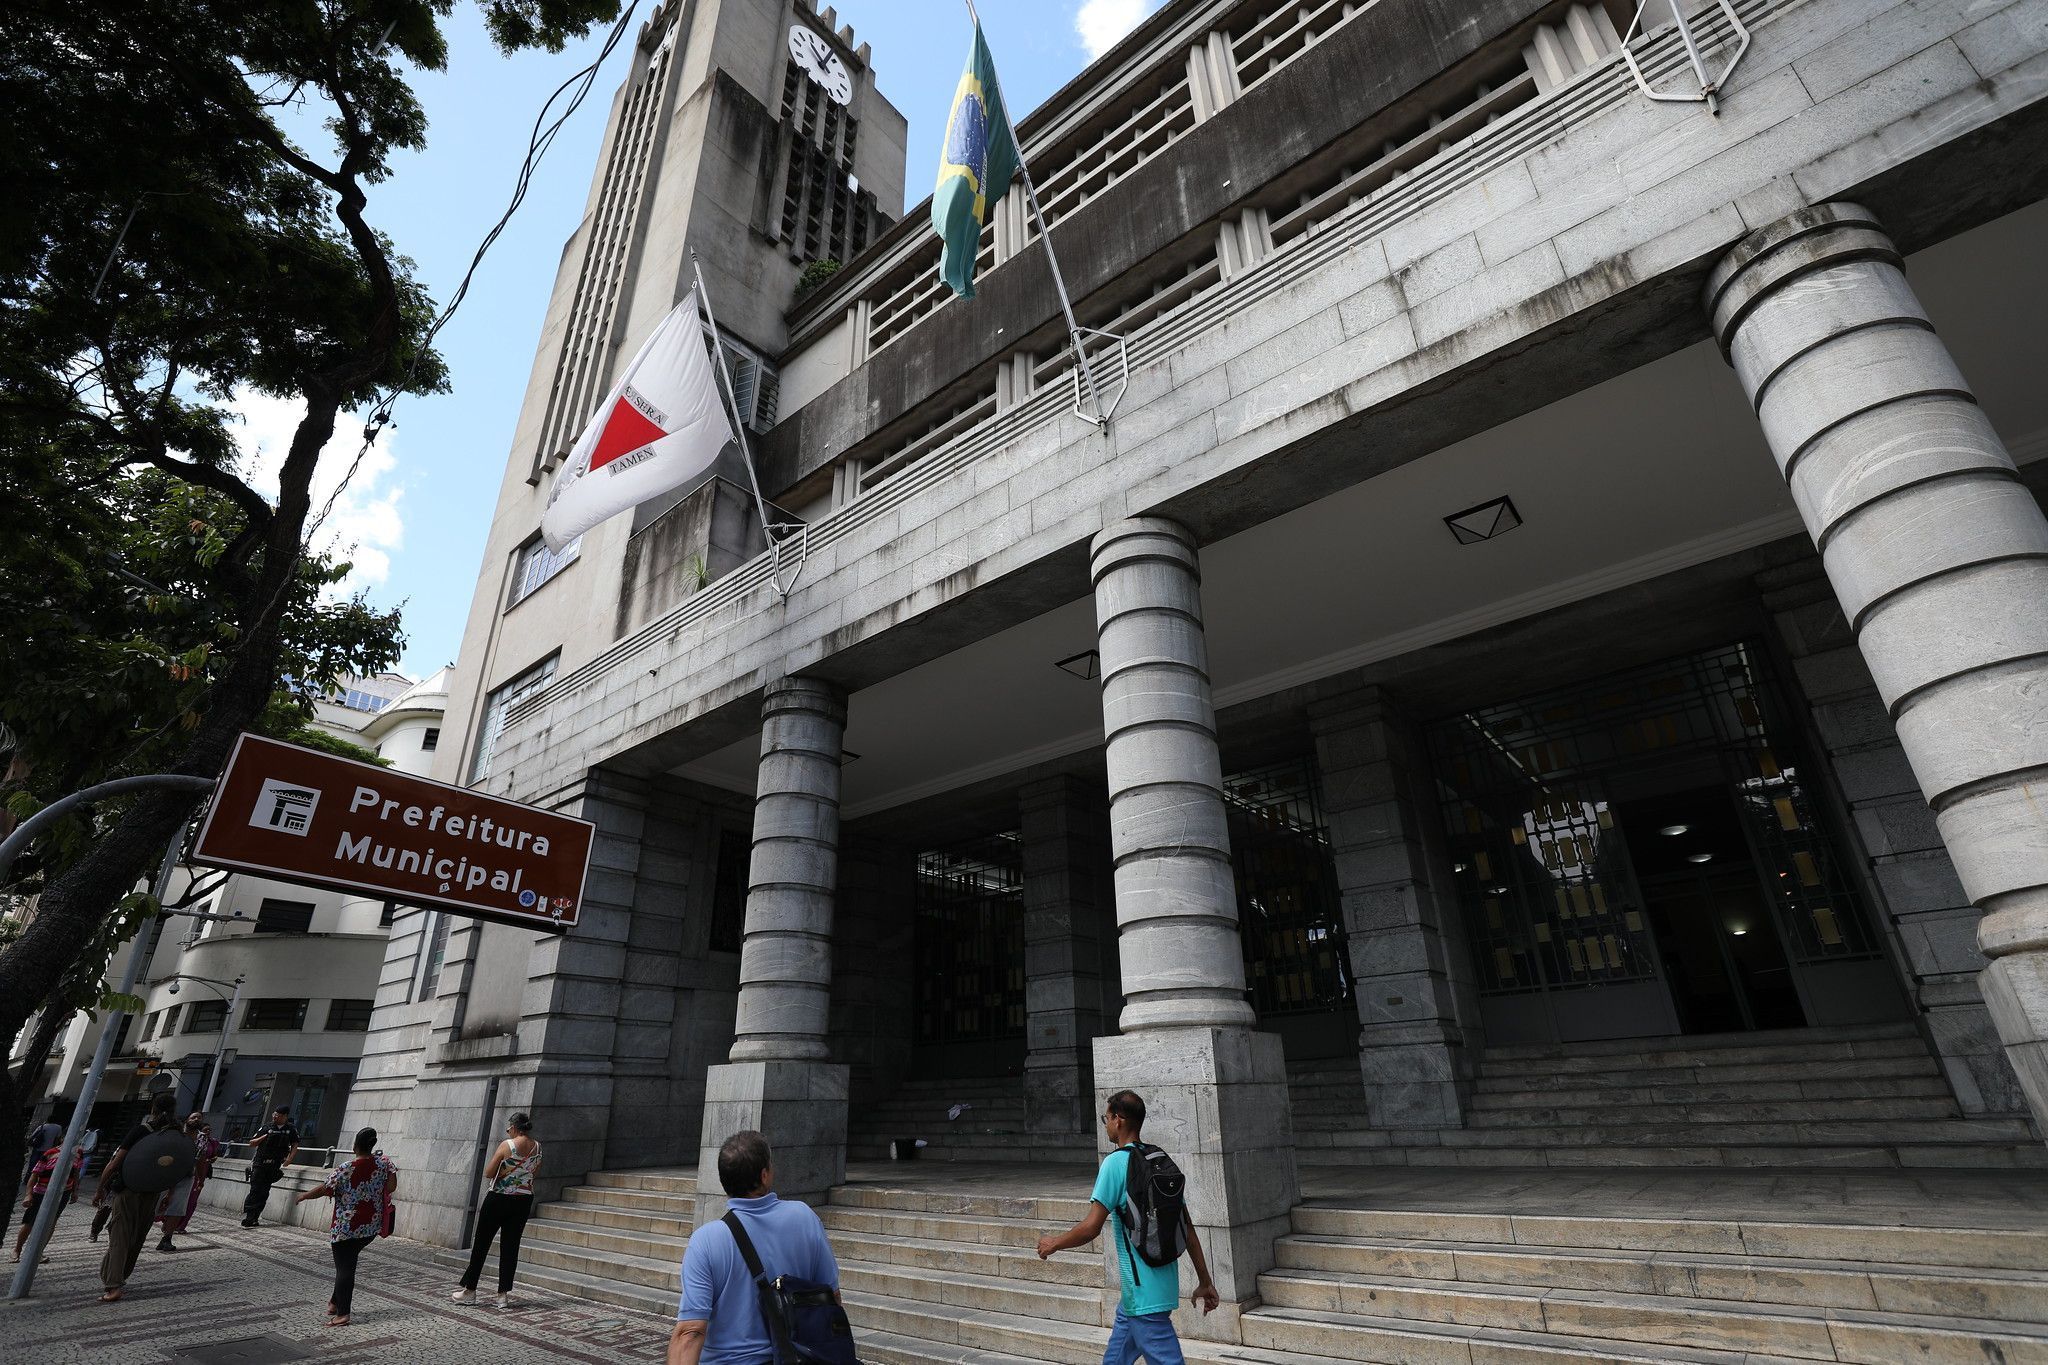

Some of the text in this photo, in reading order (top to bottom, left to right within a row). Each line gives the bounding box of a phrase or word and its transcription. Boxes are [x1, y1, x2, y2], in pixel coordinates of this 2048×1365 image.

[634, 396, 662, 425] SERA
[609, 446, 654, 474] TAMEN
[348, 786, 550, 857] Prefeitura
[334, 831, 524, 894] Municipal
